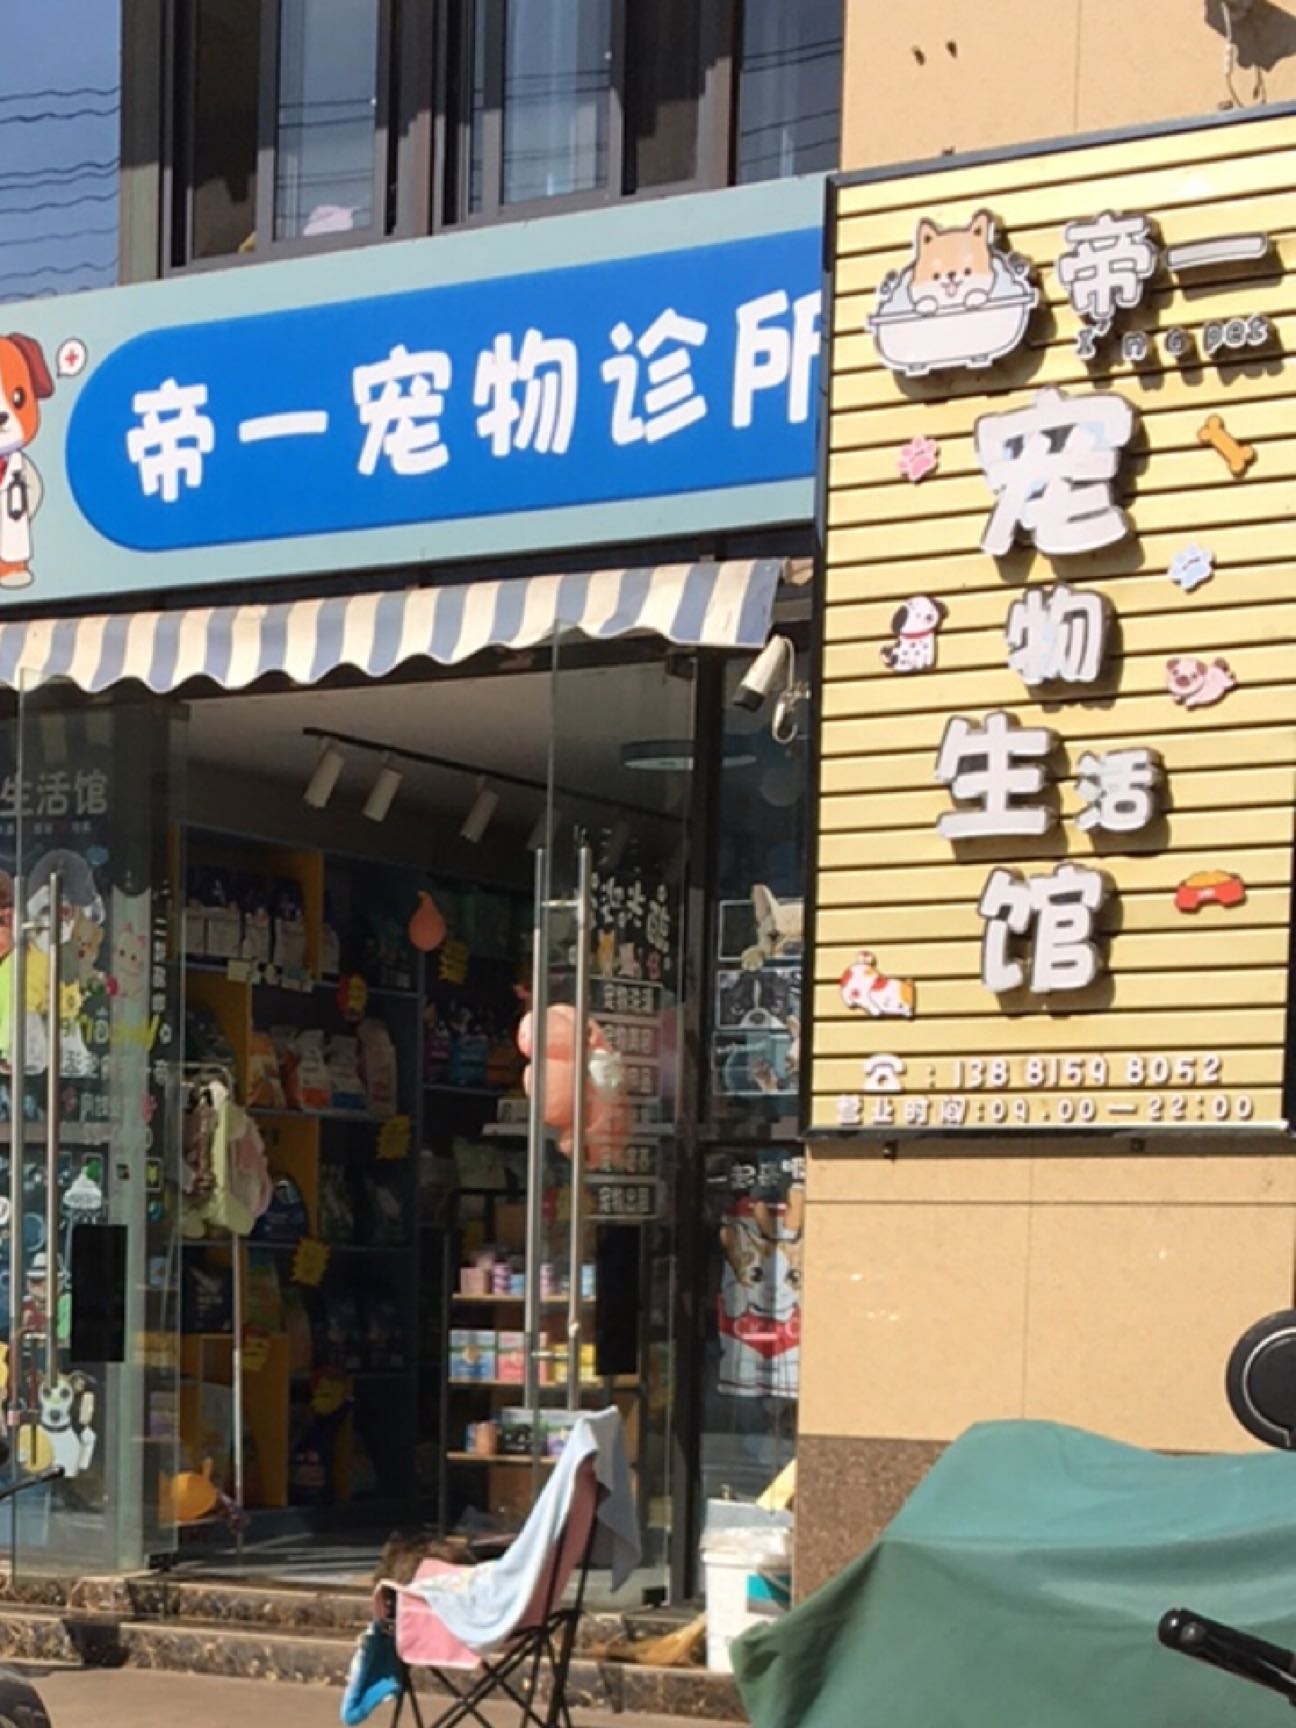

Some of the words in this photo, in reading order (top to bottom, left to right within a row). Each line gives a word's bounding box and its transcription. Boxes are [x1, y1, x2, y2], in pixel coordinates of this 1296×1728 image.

[1056, 210, 1269, 320] 帝一
[124, 287, 822, 504] 帝一宠物诊所
[953, 1057, 1009, 1089] 138
